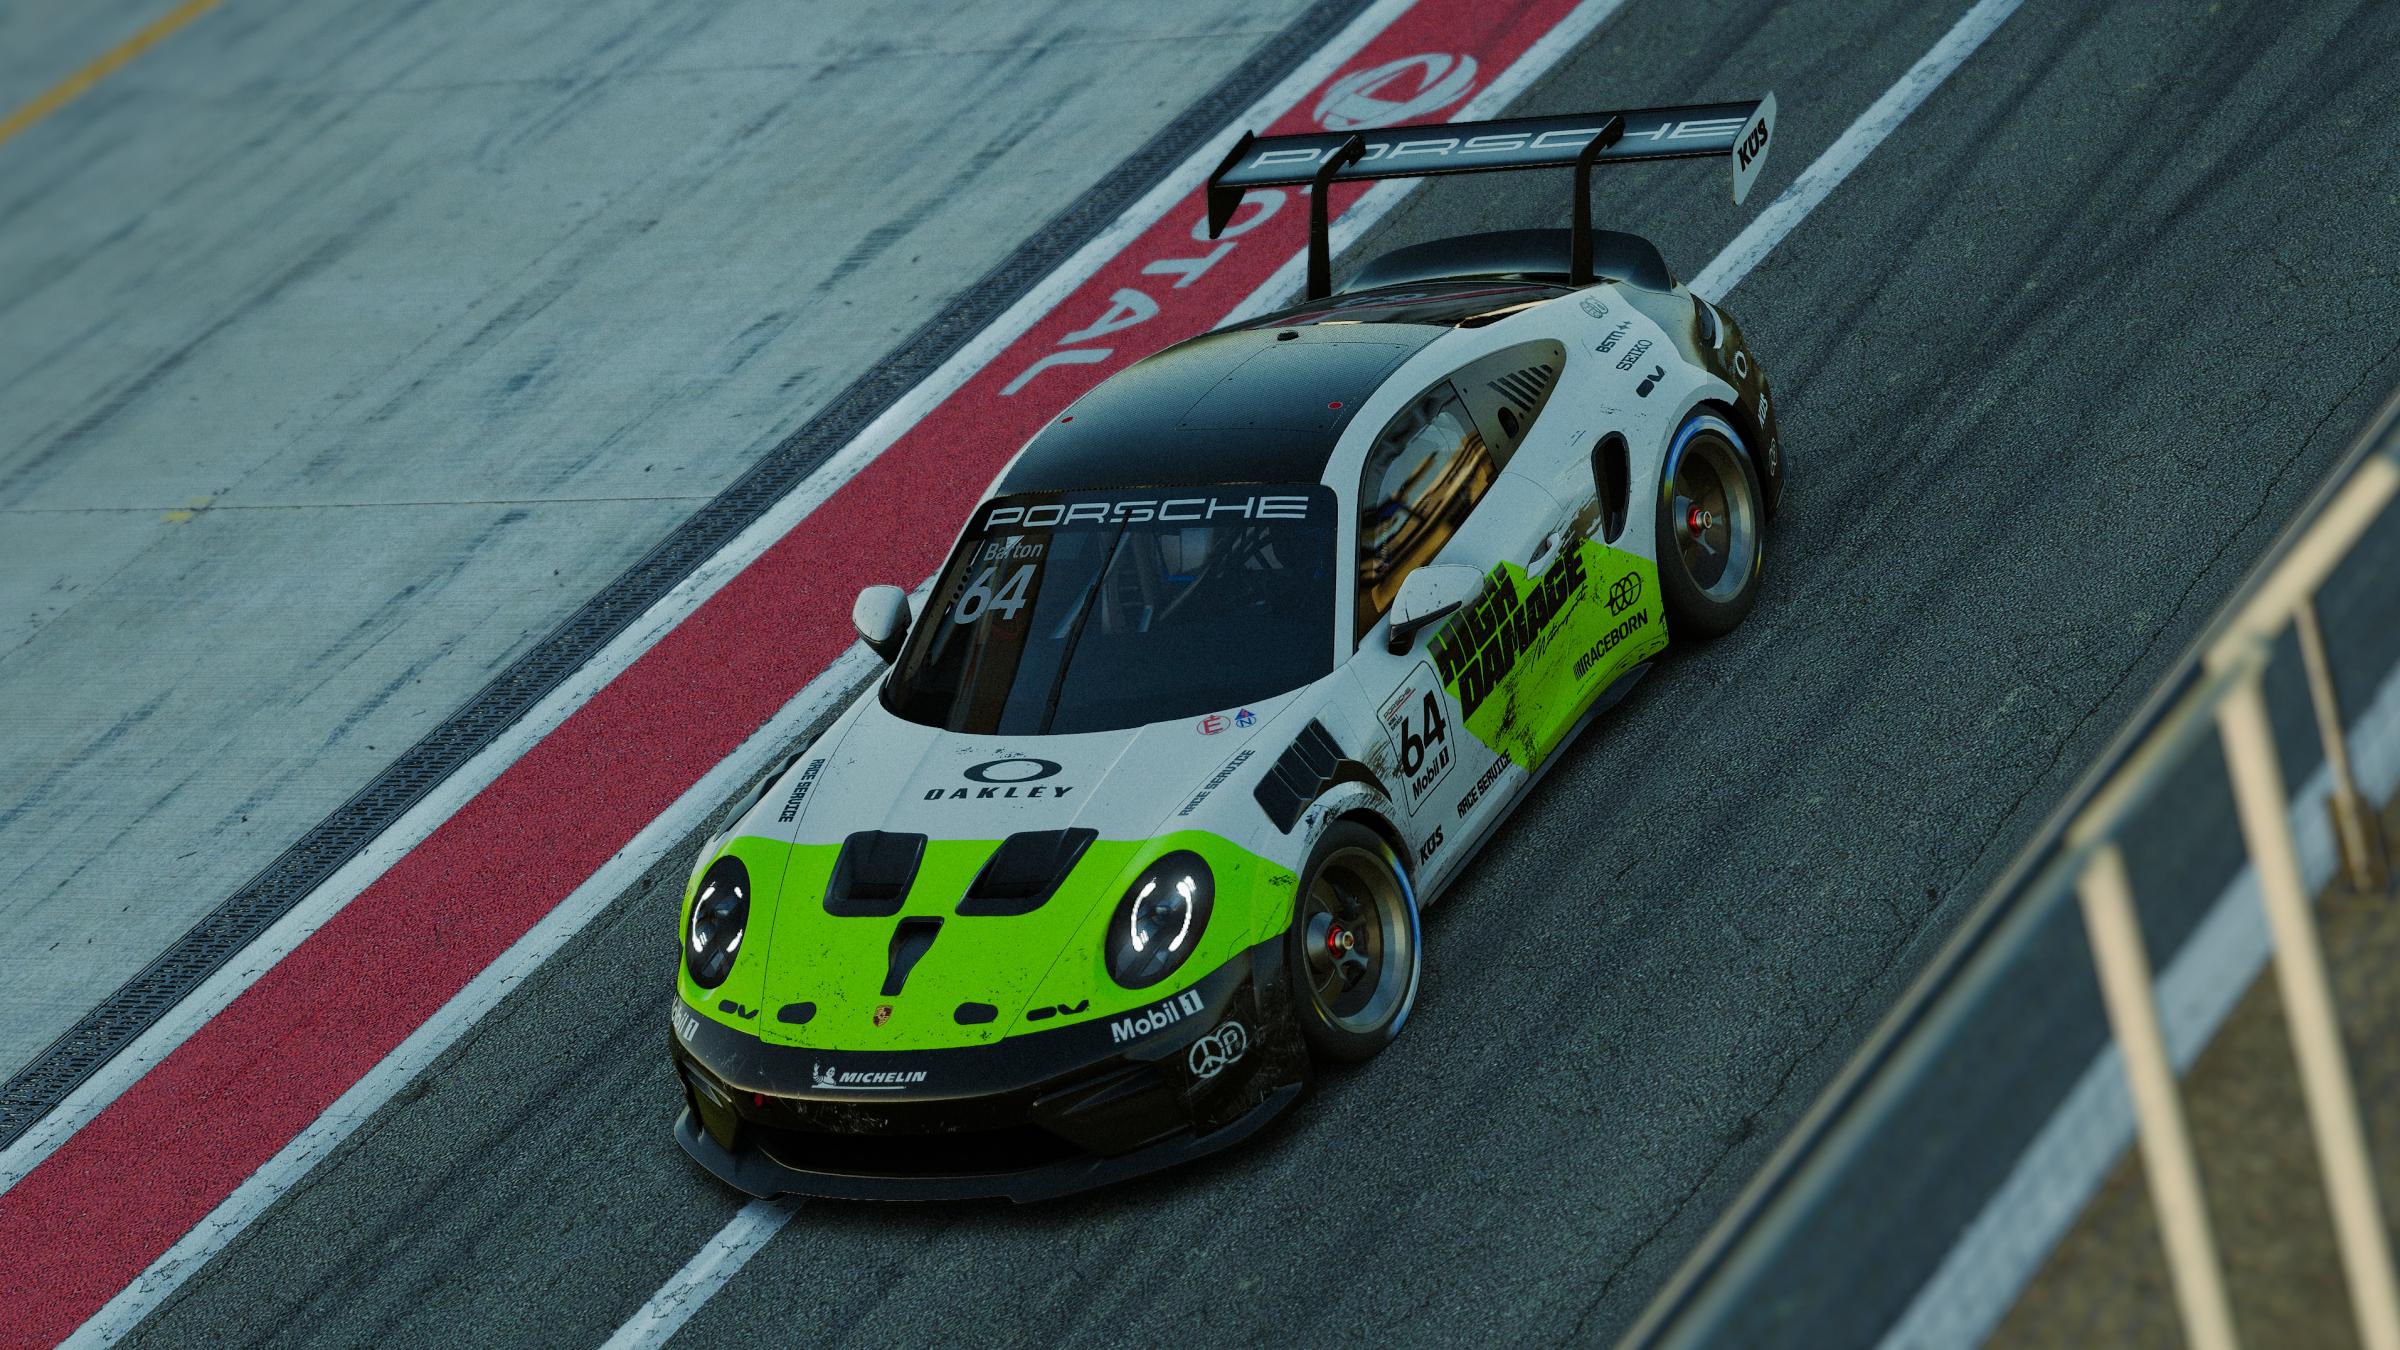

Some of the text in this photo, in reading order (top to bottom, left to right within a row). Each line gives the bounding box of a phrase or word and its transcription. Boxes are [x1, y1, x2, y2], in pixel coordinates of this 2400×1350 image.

[1616, 339, 1653, 371] SEIKO
[983, 496, 1308, 532] PORSCHE
[953, 564, 1038, 625] 64
[1426, 563, 1518, 690] HIGH
[1460, 541, 1588, 723] DAMAGE
[1578, 609, 1649, 676] RACEBORN
[1401, 690, 1447, 778] 64
[801, 758, 826, 780] RACE
[1412, 757, 1440, 800] Mobil
[923, 786, 1074, 800] OAKLEY
[1177, 791, 1211, 816] RACE
[1457, 787, 1479, 819] RACE
[1110, 989, 1205, 1044] Mobil 1
[839, 1071, 928, 1083] MICHELIN
